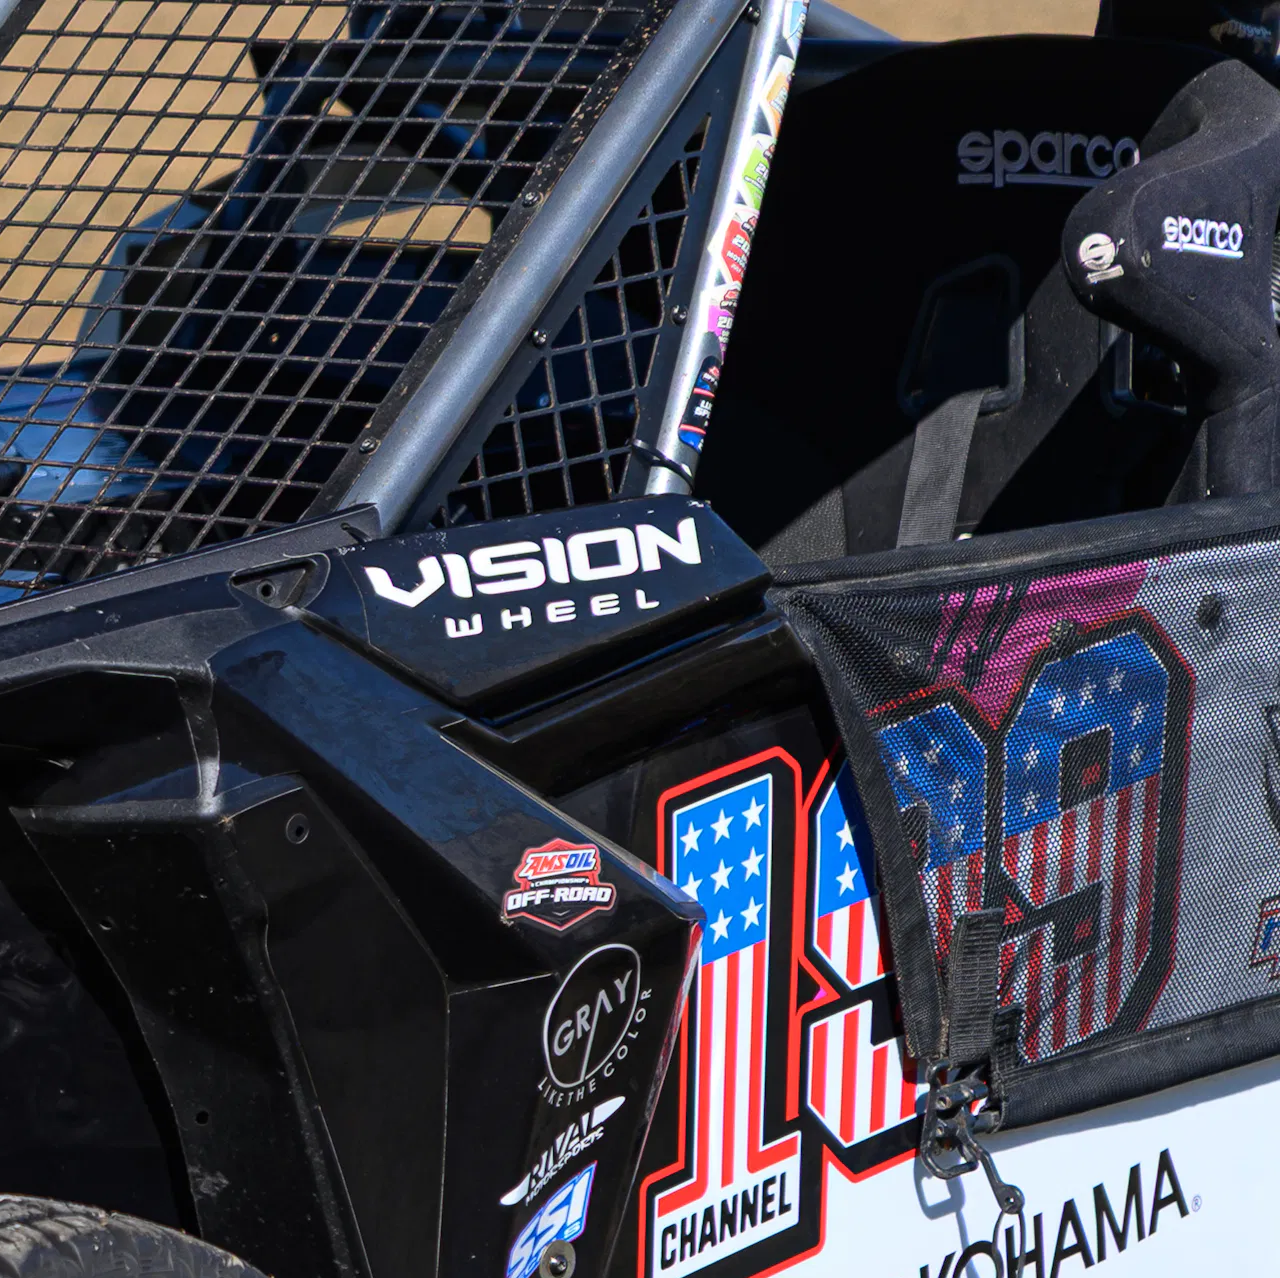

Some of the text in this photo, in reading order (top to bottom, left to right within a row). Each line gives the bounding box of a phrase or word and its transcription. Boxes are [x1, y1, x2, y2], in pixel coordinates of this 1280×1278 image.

[958, 130, 1139, 187] sparco
[1163, 216, 1244, 254] sparco
[364, 517, 702, 608] VISION
[445, 588, 660, 639] WHEEL
[506, 886, 613, 911] OFF-ROAD
[522, 850, 596, 878] AMSOIL
[537, 988, 652, 1108] LIKE THE COLOR
[553, 969, 634, 1080] GRAY
[524, 1126, 605, 1207] MOTORSPORTS
[508, 1170, 590, 1274] SSI
[660, 1171, 793, 1272] CHANNEL
